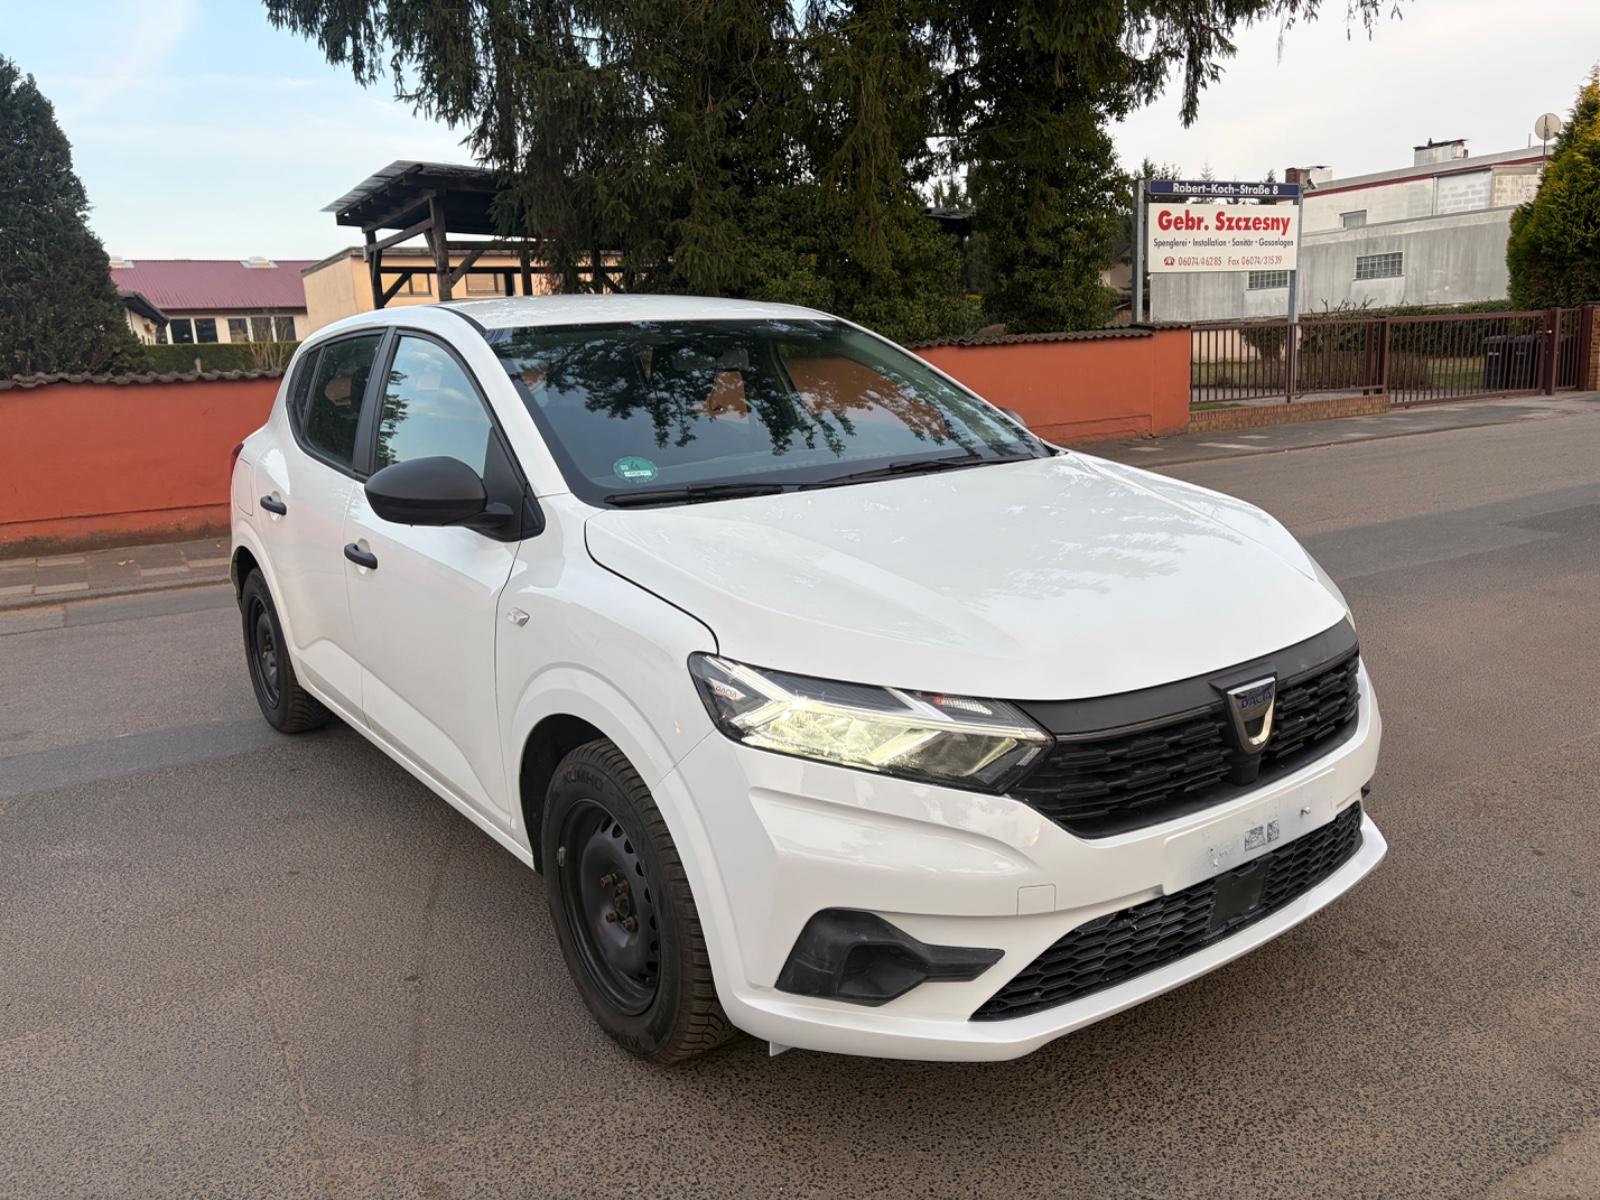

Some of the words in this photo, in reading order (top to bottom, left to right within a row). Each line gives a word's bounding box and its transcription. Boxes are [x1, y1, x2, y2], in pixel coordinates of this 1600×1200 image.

[1173, 182, 1270, 195] Robert-Koch-Straße
[1272, 185, 1279, 195] 8
[1158, 209, 1210, 231] Gebr.
[1215, 211, 1291, 236] Szczesny
[1153, 238, 1188, 249] Spenglerei
[1192, 238, 1227, 247] Installation
[1258, 238, 1294, 248] Gasanlagen
[1228, 256, 1240, 265] Fax
